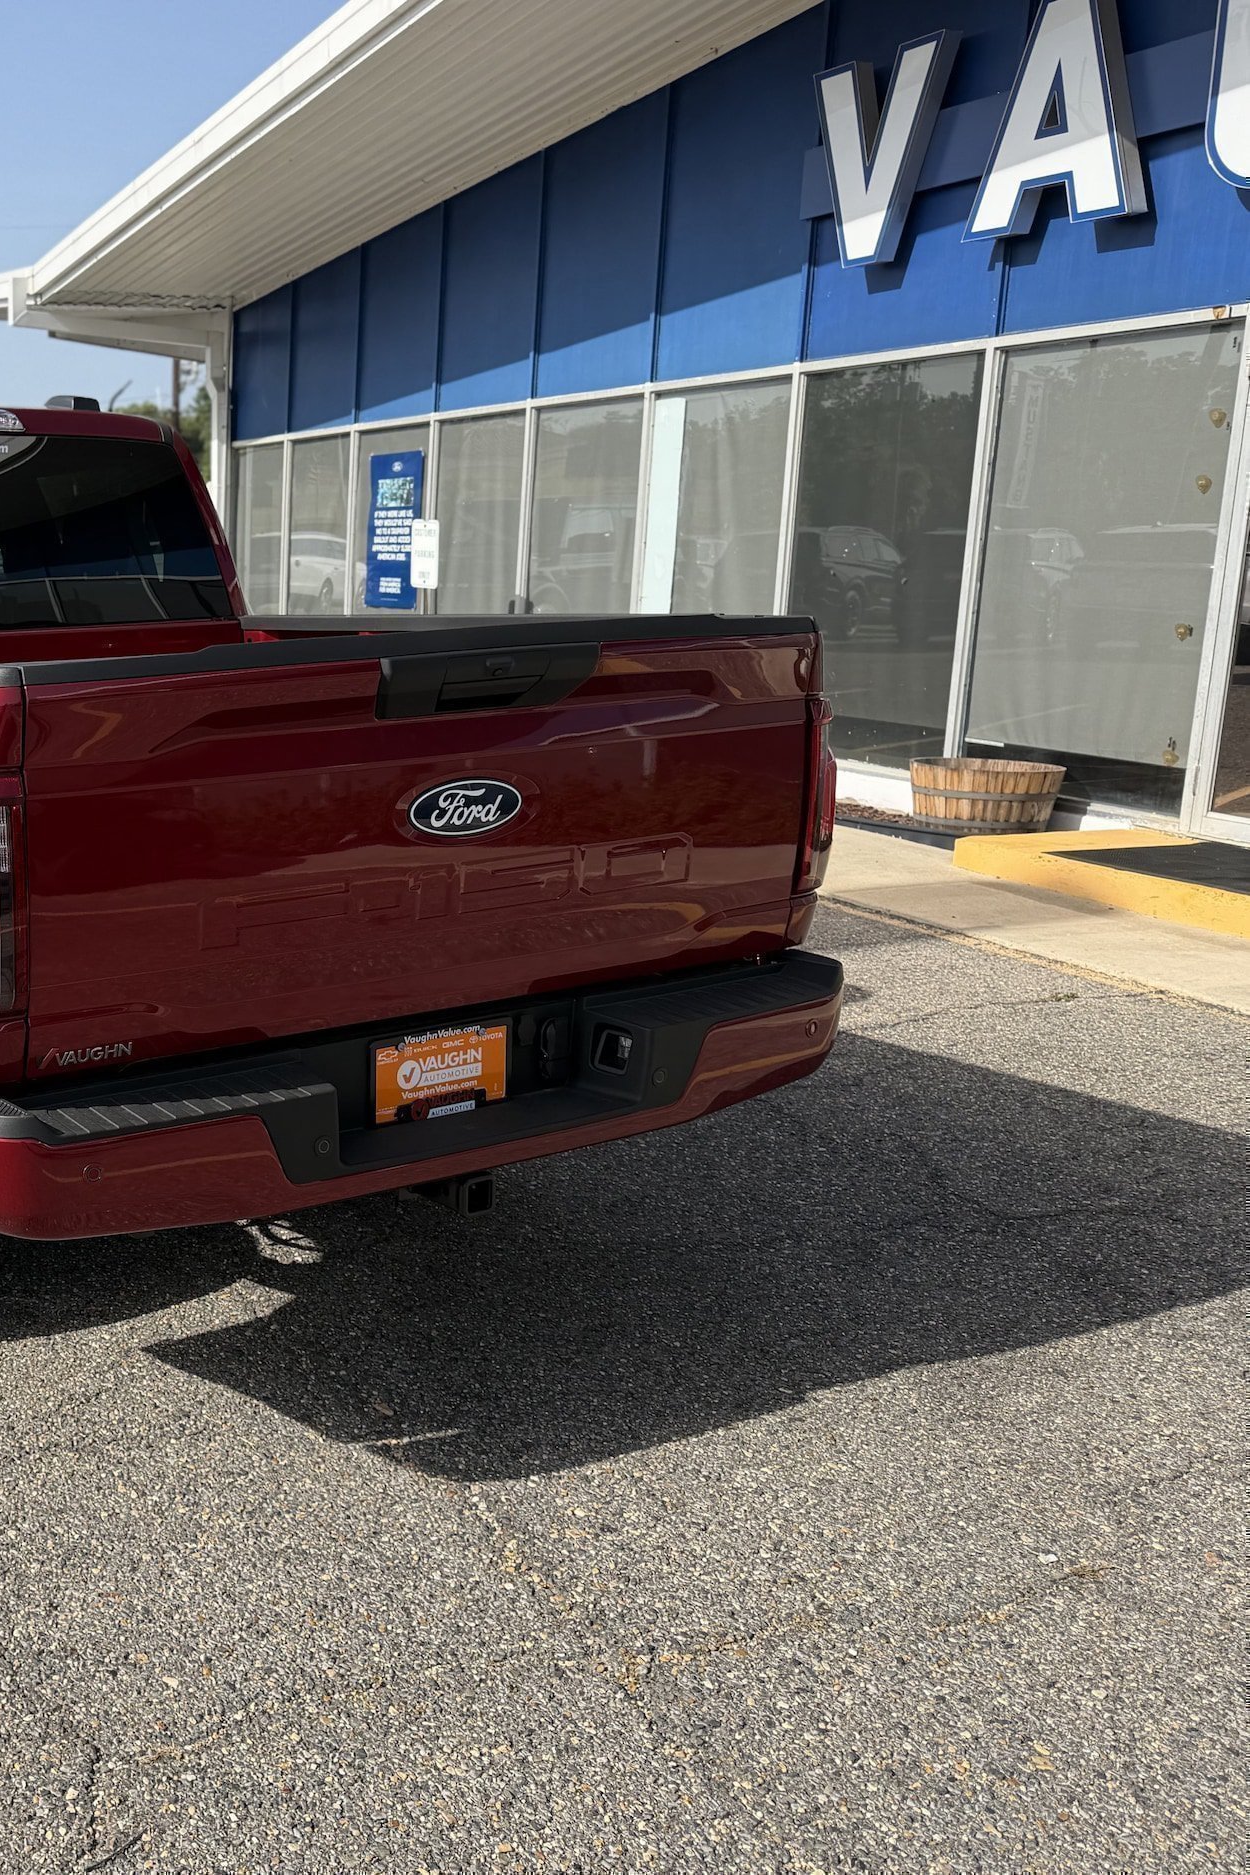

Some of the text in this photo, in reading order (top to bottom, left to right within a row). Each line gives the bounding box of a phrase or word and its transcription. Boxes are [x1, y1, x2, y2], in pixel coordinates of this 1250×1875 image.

[430, 788, 504, 828] Ford
[404, 1024, 481, 1045] VaughnValue.com
[442, 1039, 464, 1049] GMC
[55, 1042, 133, 1067] VAUGHN
[419, 1047, 482, 1072] VAUGHN
[423, 1065, 480, 1083] AUTOMOTIVE
[401, 1080, 478, 1100] VaughnValue.com
[431, 1102, 474, 1116] AUTOMOTIVE
